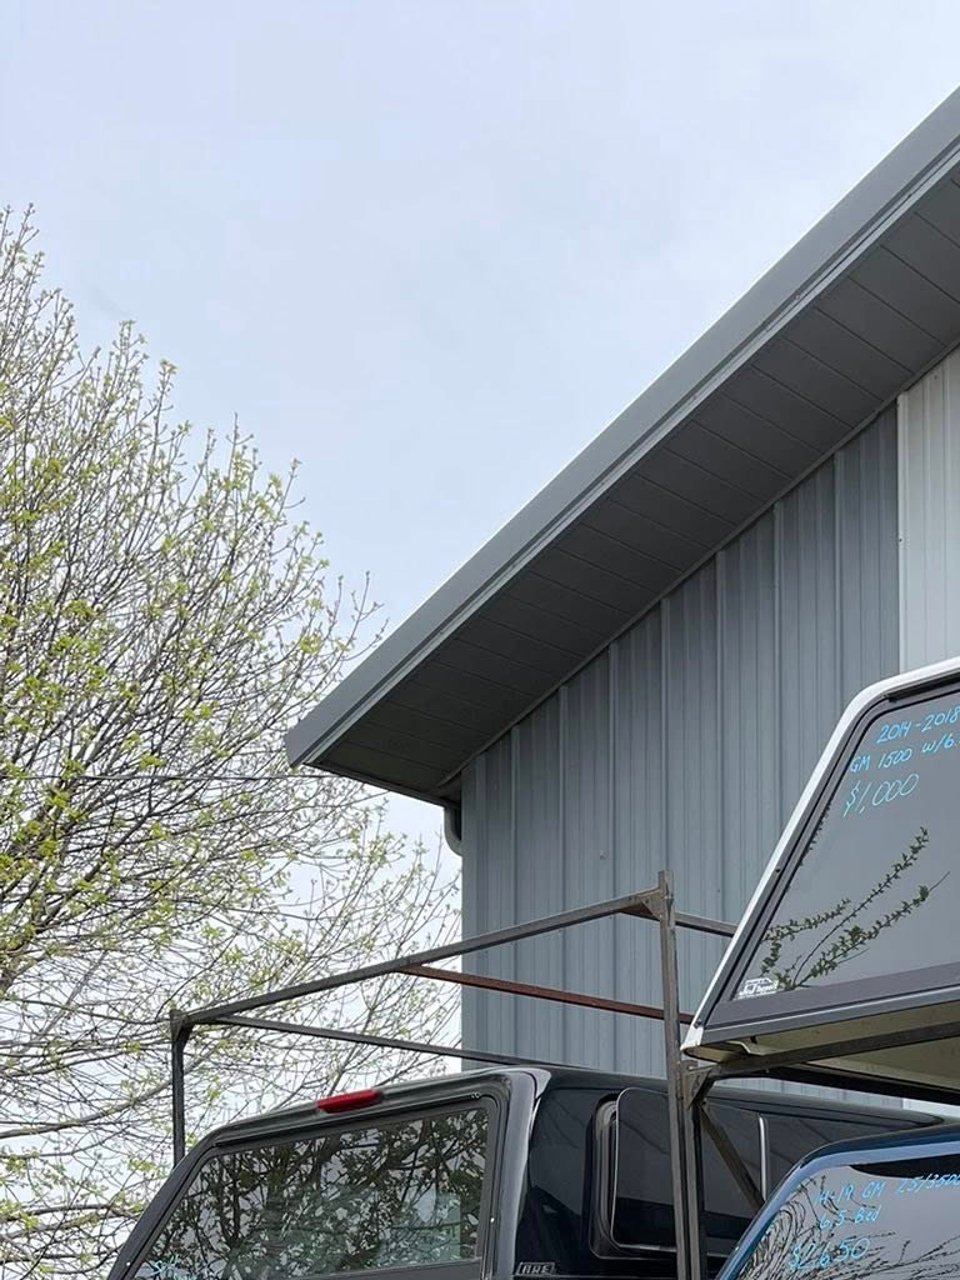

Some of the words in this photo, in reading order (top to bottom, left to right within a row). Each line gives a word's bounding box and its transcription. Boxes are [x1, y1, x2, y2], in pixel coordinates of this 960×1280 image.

[878, 748, 913, 769] 1500
[843, 773, 919, 817] $1,000
[862, 1180, 886, 1200] GM
